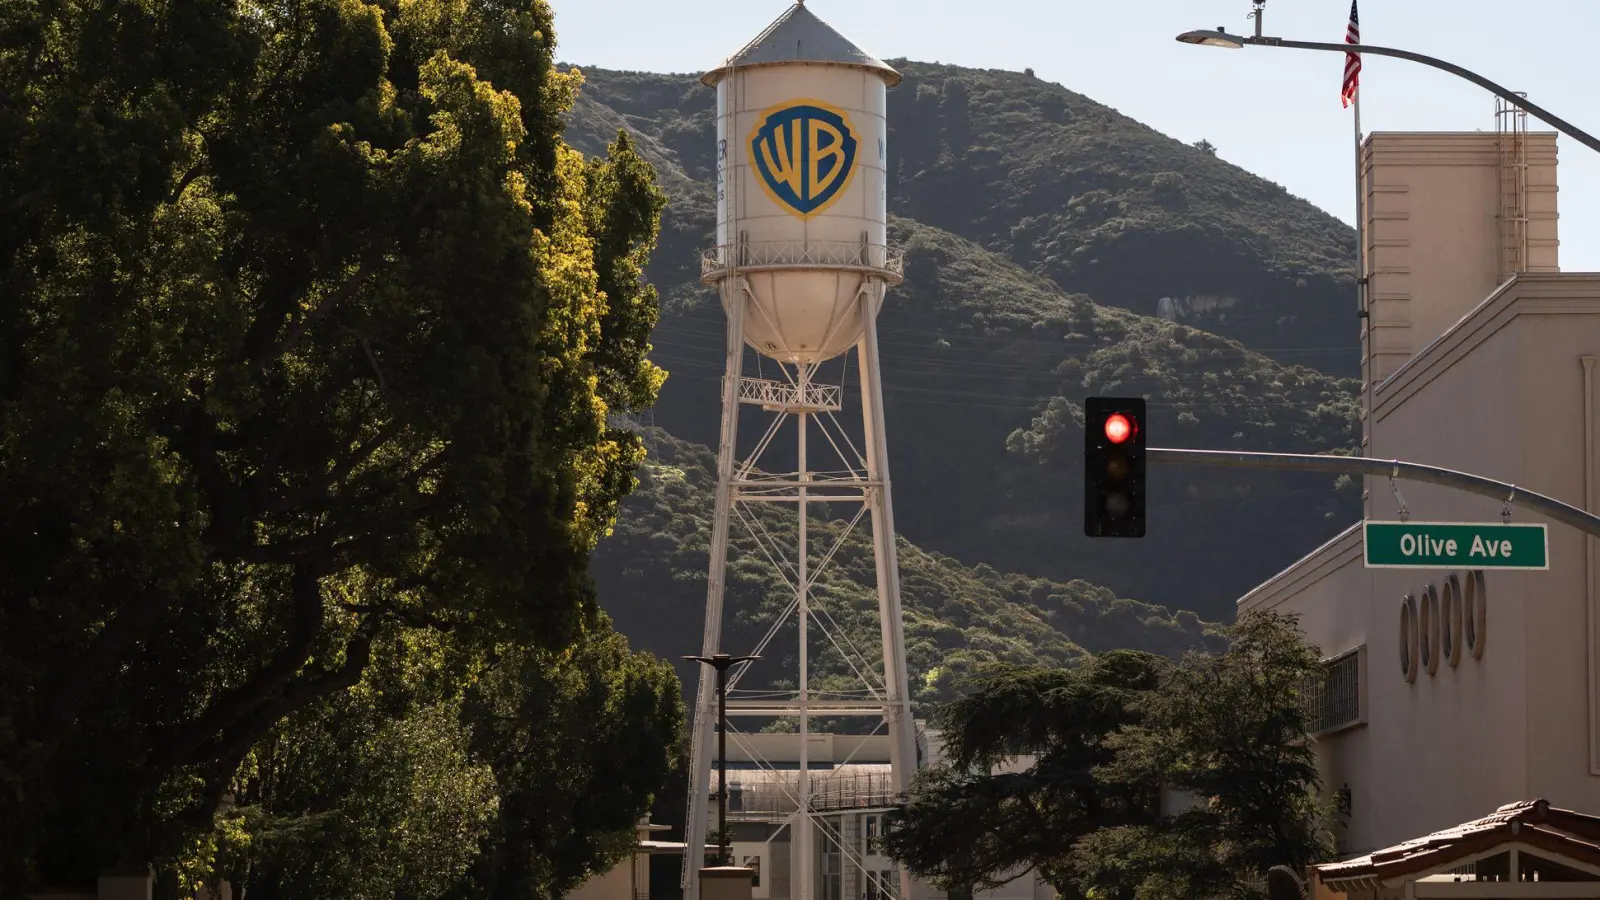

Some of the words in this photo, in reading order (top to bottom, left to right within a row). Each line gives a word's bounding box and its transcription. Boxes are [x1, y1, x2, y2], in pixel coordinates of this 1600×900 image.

[760, 118, 846, 200] WB
[1400, 533, 1458, 557] Olive
[1469, 534, 1513, 558] Ave
